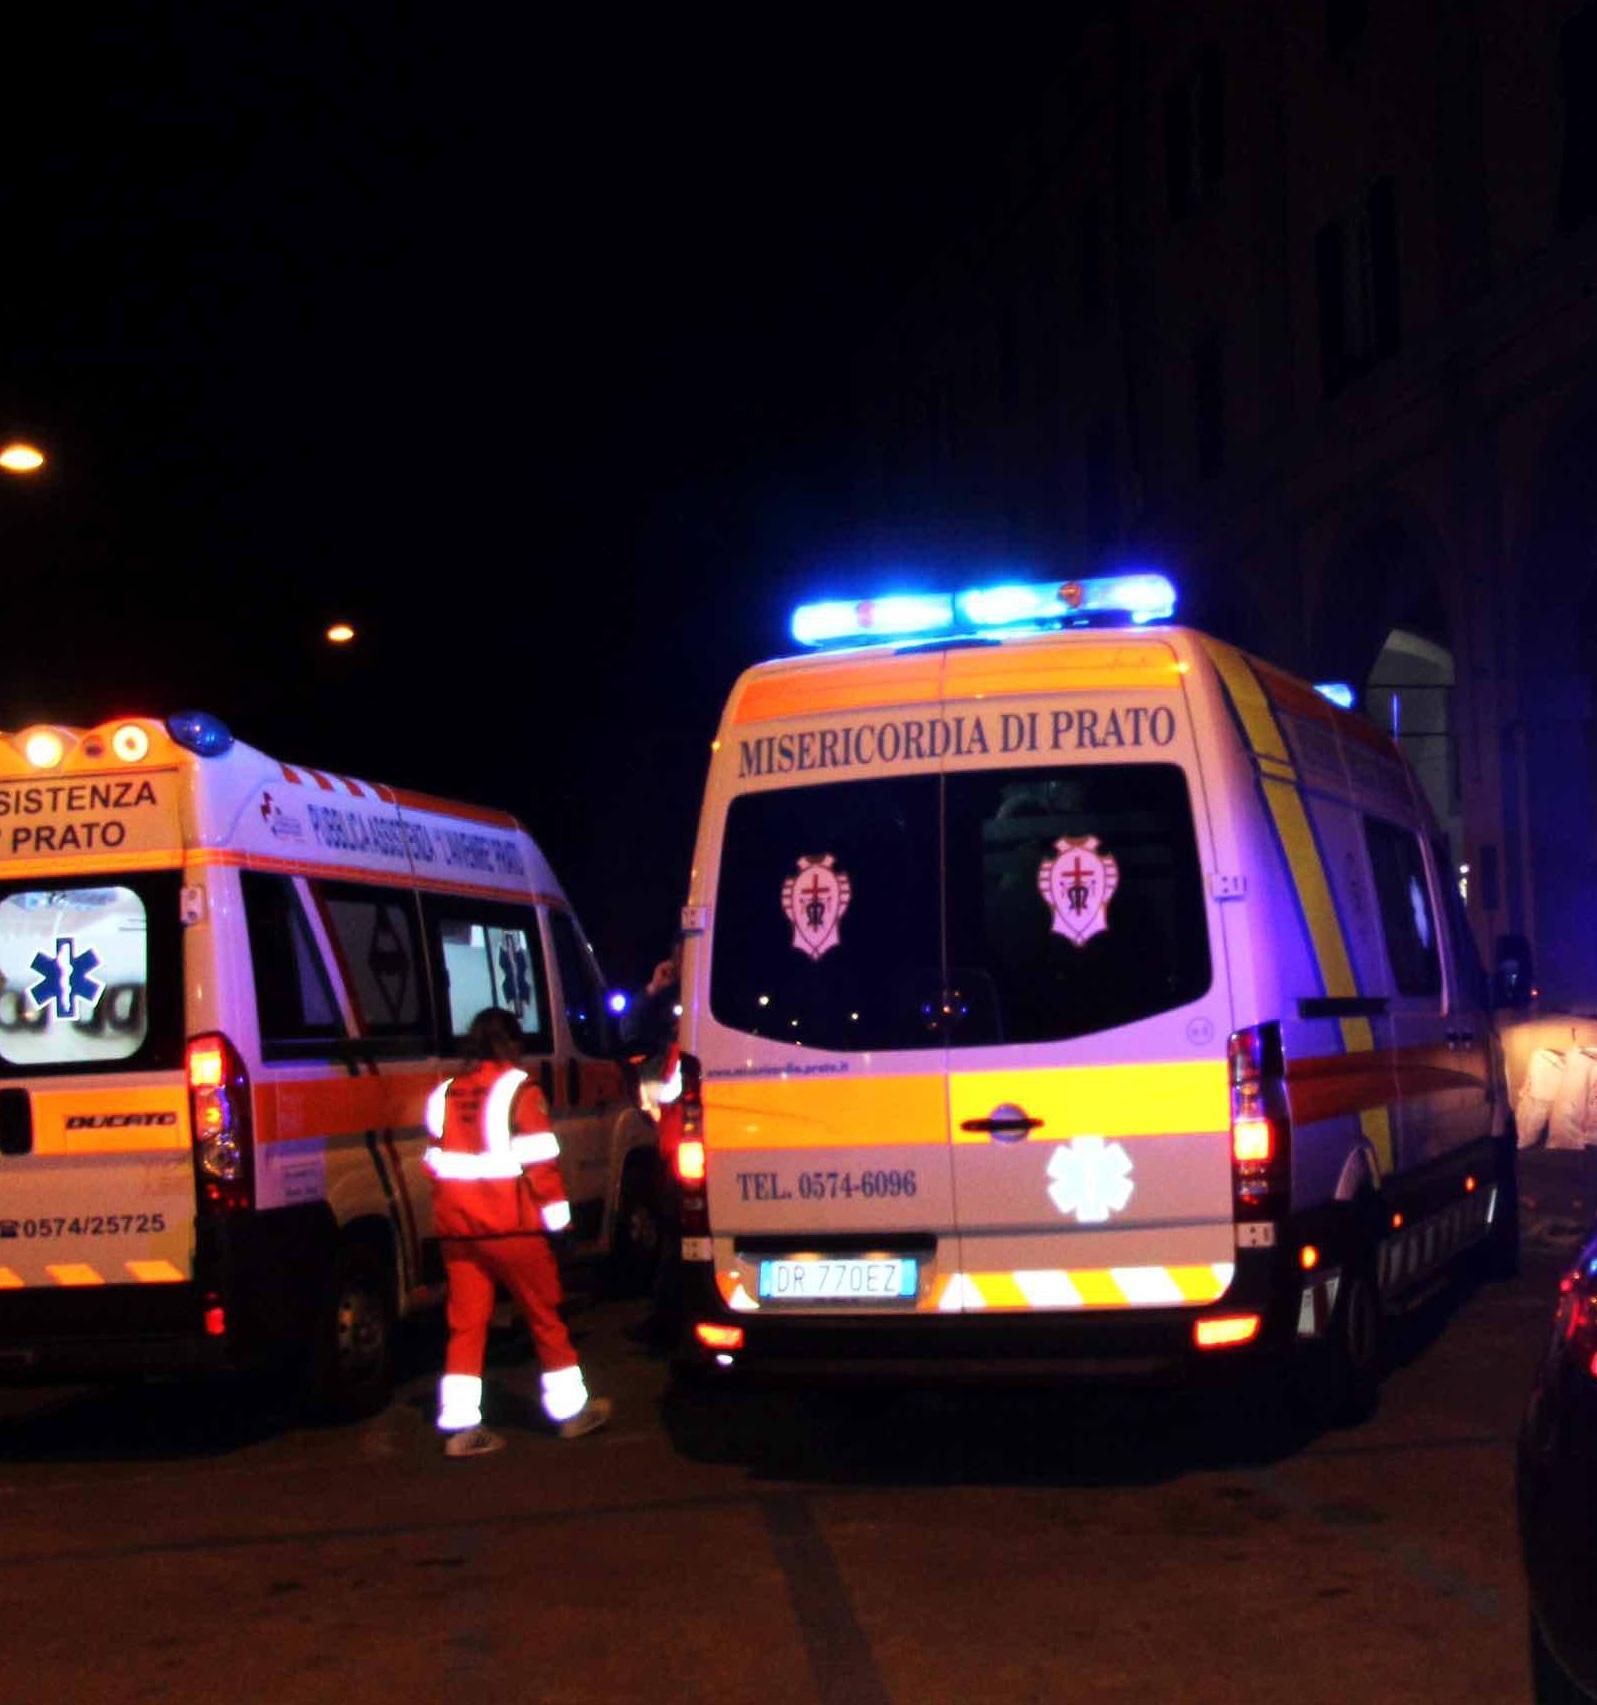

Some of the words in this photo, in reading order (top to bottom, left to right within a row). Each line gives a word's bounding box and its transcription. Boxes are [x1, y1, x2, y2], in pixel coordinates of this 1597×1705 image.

[738, 715, 990, 778] MISERICORDIA
[999, 712, 1039, 753] DI
[1050, 706, 1177, 751] PRATO
[0, 781, 157, 816] SISTENZA
[12, 821, 126, 854] PRATO
[66, 1112, 176, 1130] DUCATO
[737, 1172, 793, 1200] TEL.
[798, 1170, 918, 1199] 0574-6096
[24, 1213, 165, 1238] 0574/25725
[777, 1265, 806, 1293] DR
